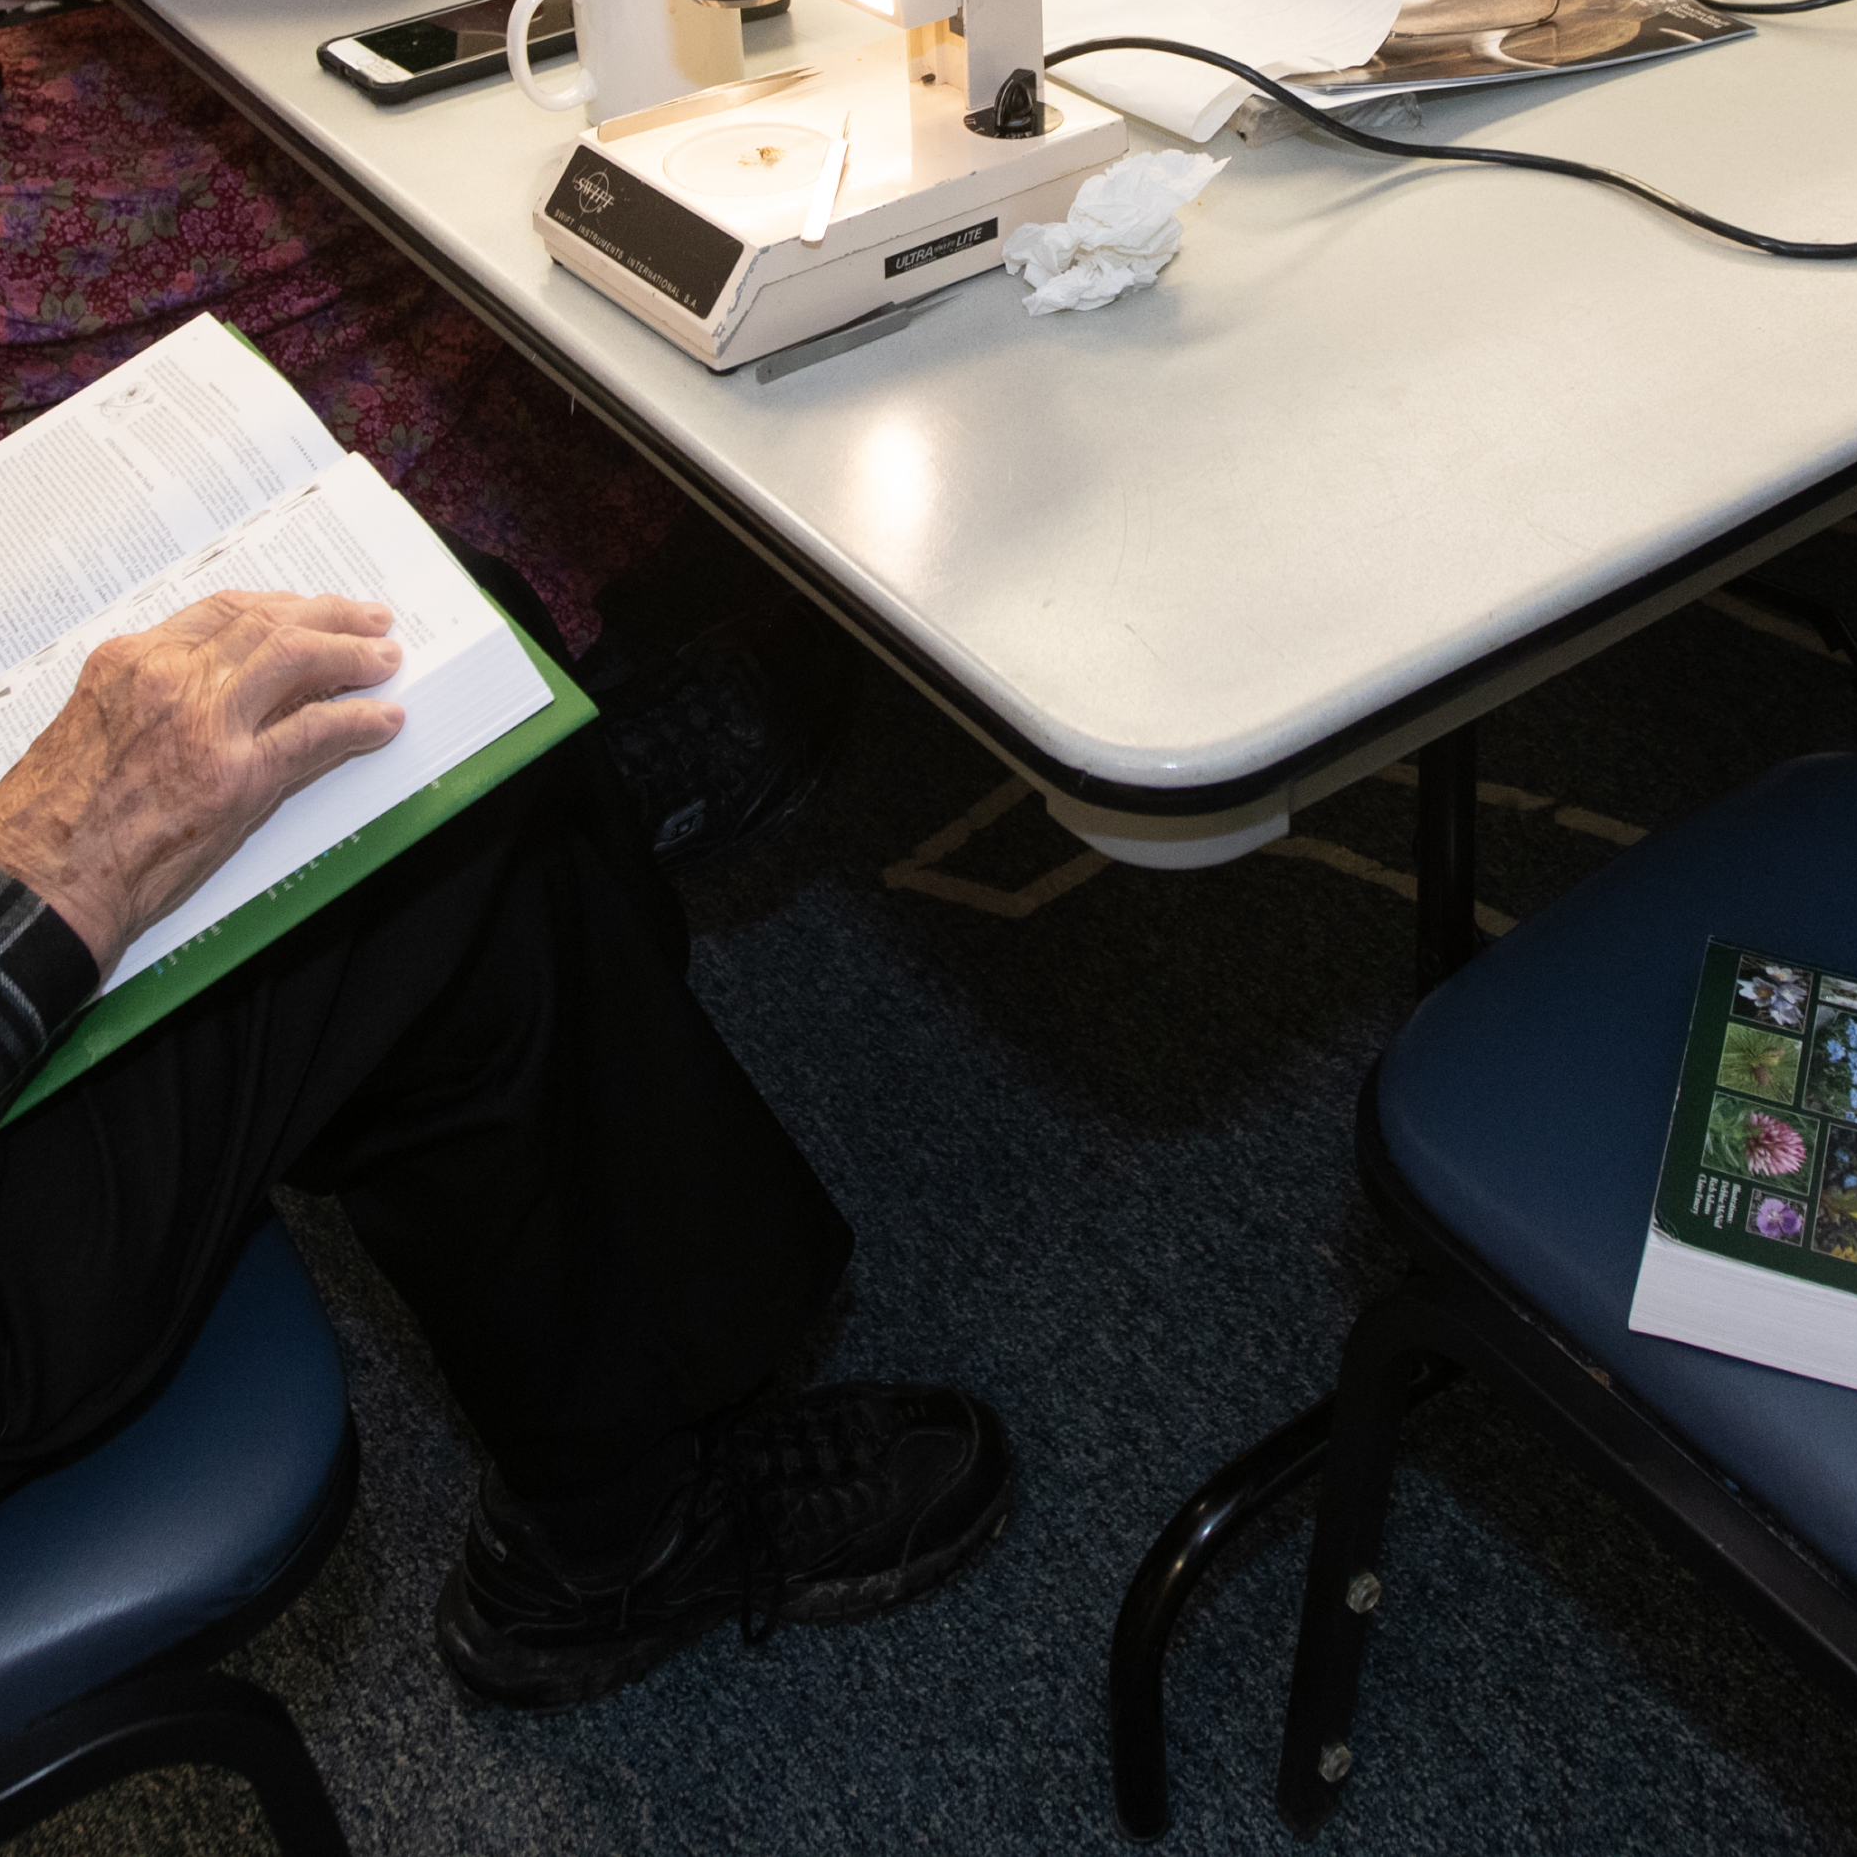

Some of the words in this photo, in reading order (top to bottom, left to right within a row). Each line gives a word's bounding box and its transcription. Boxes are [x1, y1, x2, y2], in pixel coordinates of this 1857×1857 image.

[573, 177, 616, 209] SWIFT
[554, 208, 575, 227] SWIFT
[578, 223, 625, 260] INSTRUMENTS
[626, 256, 681, 299] INTERNATIONAL
[895, 246, 934, 270] ULTRA
[955, 227, 983, 247] LITE
[1696, 1173, 1708, 1193] Claire
[1689, 1192, 1704, 1216] Emery
